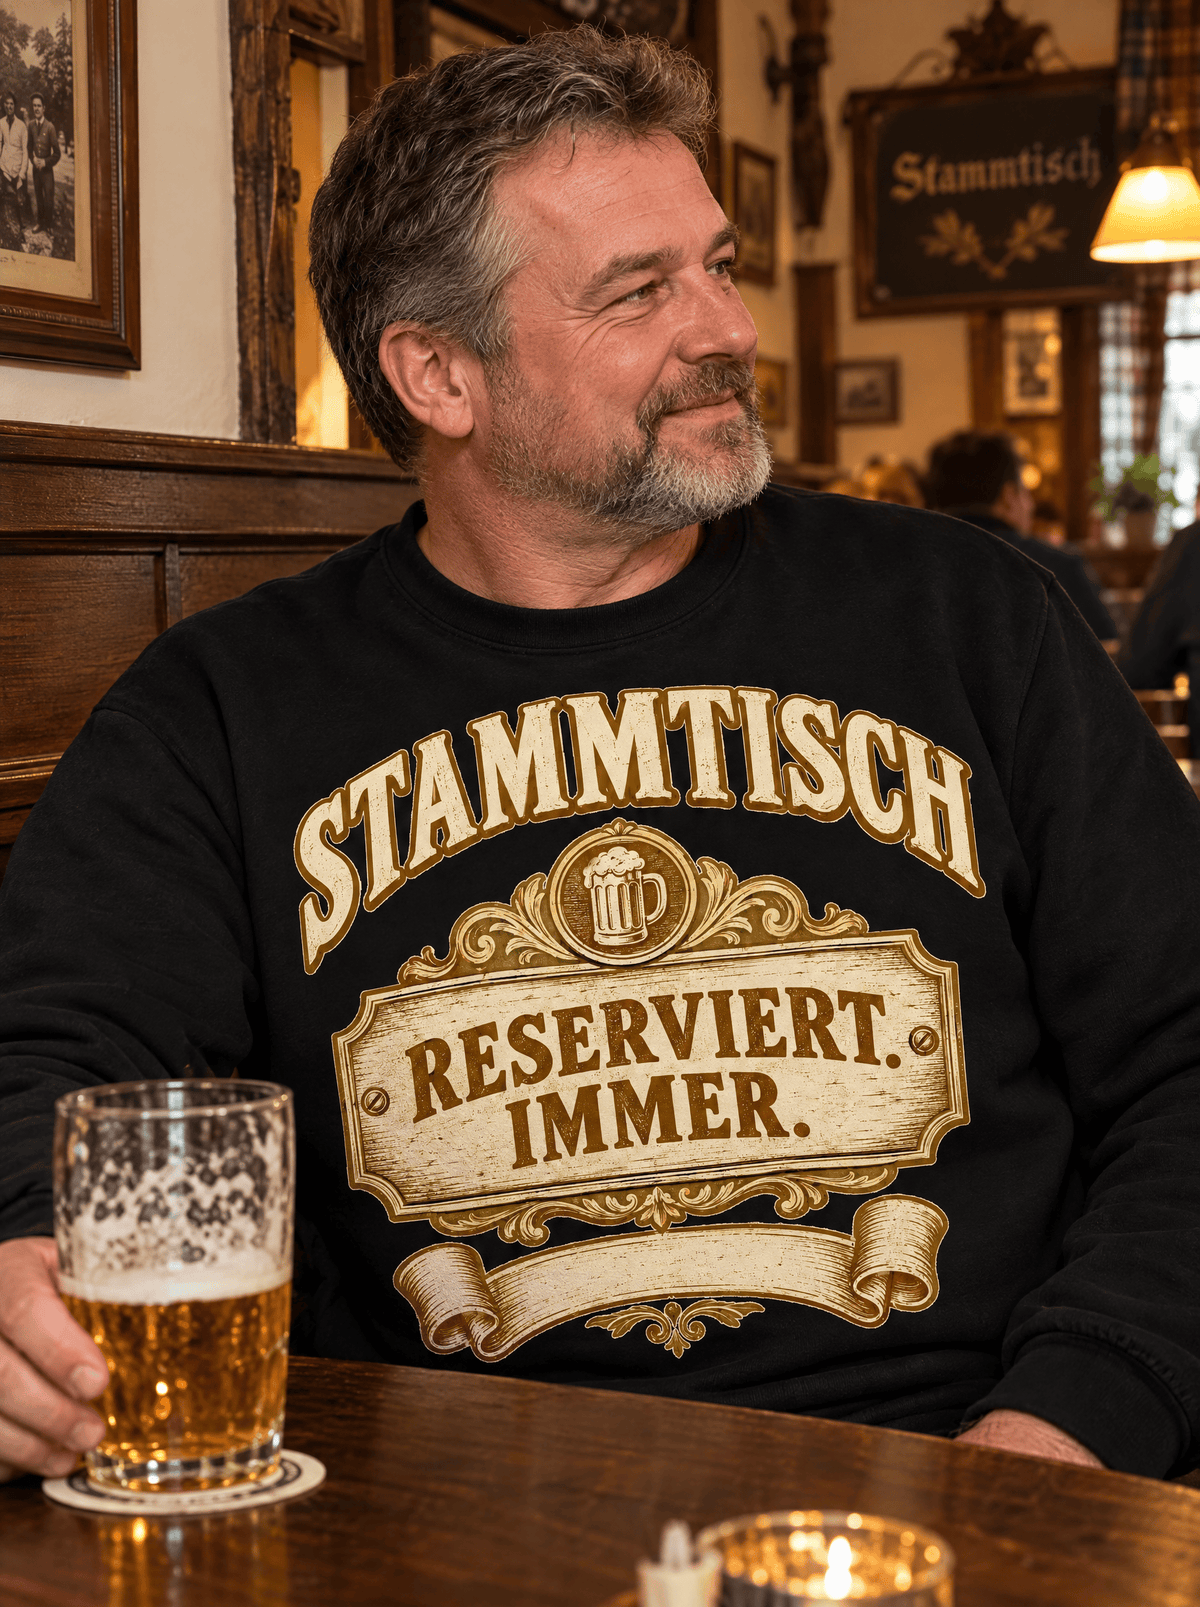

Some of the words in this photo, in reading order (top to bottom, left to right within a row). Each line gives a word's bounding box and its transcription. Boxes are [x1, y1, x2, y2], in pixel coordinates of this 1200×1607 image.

[889, 136, 1102, 202] Stammtisch
[294, 685, 987, 975] STAMMTISCH
[405, 987, 902, 1122] RESERVIERT.
[504, 1071, 811, 1170] IMMER.
